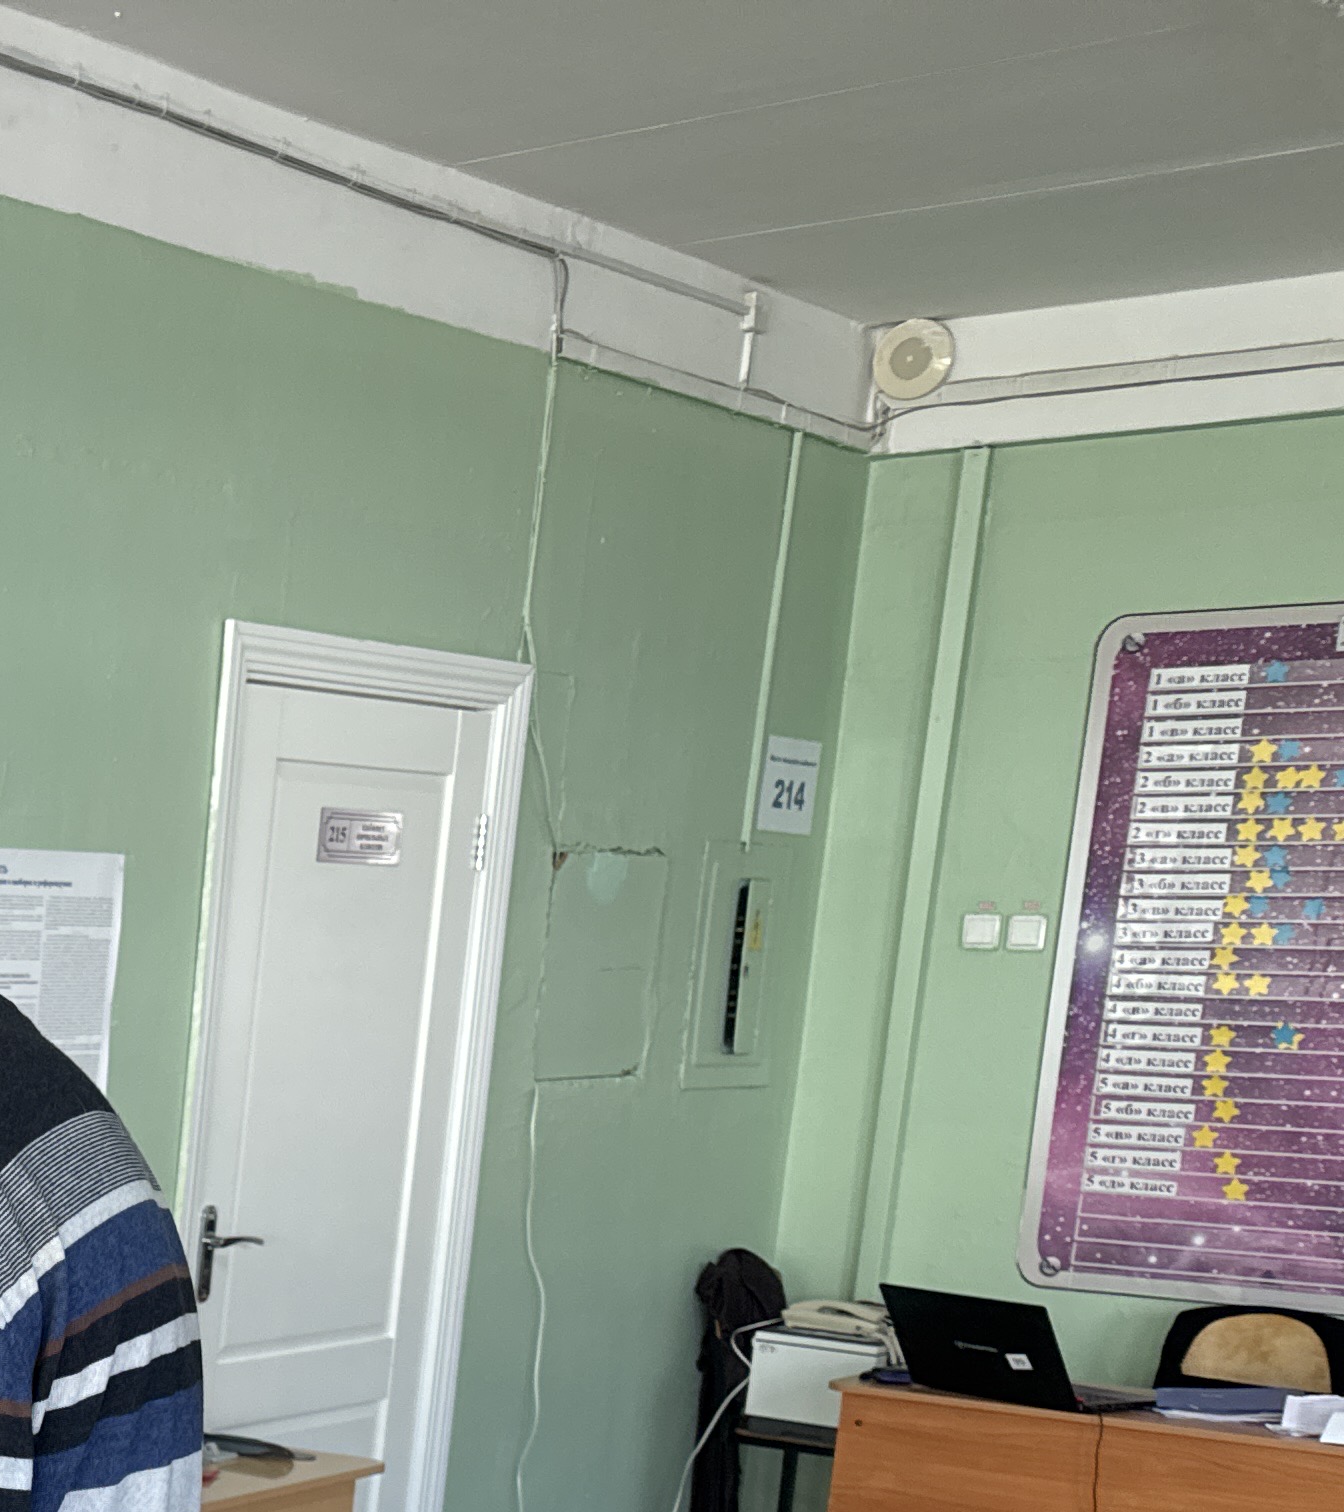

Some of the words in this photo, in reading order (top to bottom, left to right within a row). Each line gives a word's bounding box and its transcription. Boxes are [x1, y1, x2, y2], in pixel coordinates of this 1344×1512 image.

[1156, 673, 1161, 685] 1
[1199, 673, 1246, 683] класс
[1153, 699, 1158, 711] 1
[1164, 698, 1191, 709] «б»
[1196, 698, 1243, 709] класс
[1149, 726, 1154, 737] 1
[1193, 726, 1239, 736] класс
[1144, 751, 1152, 763] 2
[1189, 751, 1236, 761] класс
[1140, 776, 1149, 788] 2
[1153, 776, 1181, 787] «б»
[1185, 778, 1232, 788] класс
[772, 779, 805, 811] 214
[1138, 802, 1146, 814] 2
[1183, 803, 1230, 813] класс
[1132, 827, 1141, 839] 2
[1176, 830, 1222, 839] класс
[1137, 852, 1145, 864] 3
[1182, 856, 1228, 865] класс
[1135, 878, 1144, 890] 3
[1148, 878, 1176, 890] «б»
[1180, 881, 1226, 890] класс
[1129, 903, 1137, 914] 3
[1174, 906, 1221, 916] класс
[1118, 927, 1127, 939] 3
[1163, 929, 1209, 939] класс
[1117, 953, 1125, 965] 4
[1161, 957, 1207, 967] класс
[1113, 978, 1121, 989] 4
[1126, 978, 1153, 990] «б»
[1157, 981, 1202, 992] класс
[1108, 1003, 1117, 1014] 4
[1154, 1007, 1199, 1017] класс
[1108, 1027, 1117, 1039] 4
[1152, 1032, 1198, 1043] класс
[1102, 1052, 1110, 1064] 4
[1146, 1057, 1192, 1068] класс
[1097, 1077, 1109, 1092] 5
[1143, 1083, 1189, 1094] класс
[1103, 1102, 1112, 1114] 5
[1116, 1103, 1142, 1115] «б»
[1146, 1108, 1192, 1119] класс
[1093, 1127, 1101, 1139] 5
[1137, 1132, 1182, 1144] класс
[1089, 1151, 1098, 1162] 5
[1132, 1156, 1177, 1168] класс
[1086, 1175, 1094, 1187] 5
[1130, 1181, 1174, 1193] класс
